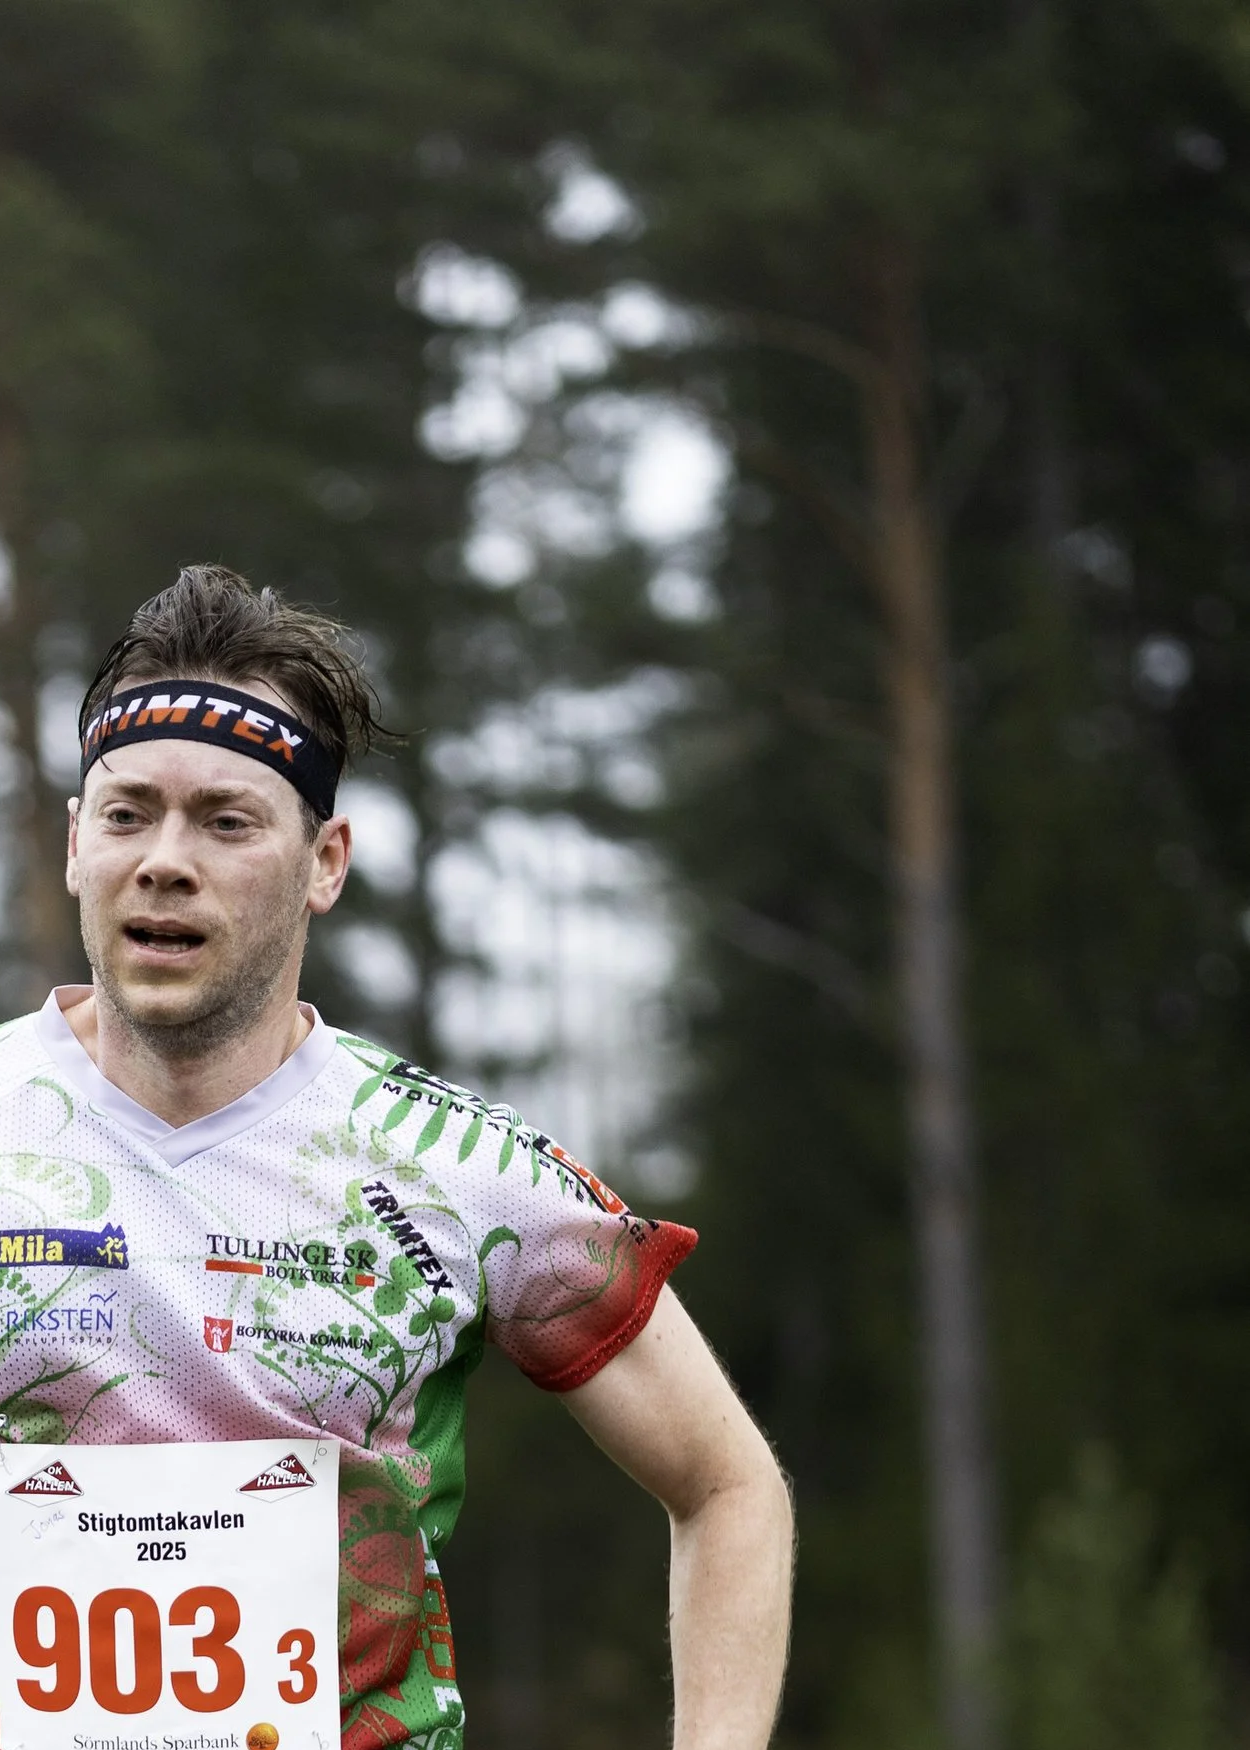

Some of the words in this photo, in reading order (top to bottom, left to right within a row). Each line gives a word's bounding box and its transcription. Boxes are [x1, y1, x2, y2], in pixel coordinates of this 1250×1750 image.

[382, 1081, 529, 1150] MOUNTAIN
[0, 1234, 64, 1264] Mila
[206, 1233, 338, 1267] TULLINGE
[343, 1247, 375, 1271] SK
[360, 1180, 455, 1297] TRIMTEX
[265, 1264, 351, 1286] BOTKYRKA
[6, 1307, 114, 1333] RIKSTEN
[236, 1324, 306, 1344] BOTKYRKA
[309, 1332, 375, 1351] KOMMUN
[47, 1465, 63, 1476] OK
[280, 1458, 297, 1469] OK
[77, 1509, 245, 1537] Stigtomtakavlen
[136, 1541, 187, 1562] 2025
[12, 1585, 246, 1715] 903
[276, 1627, 318, 1705] 3
